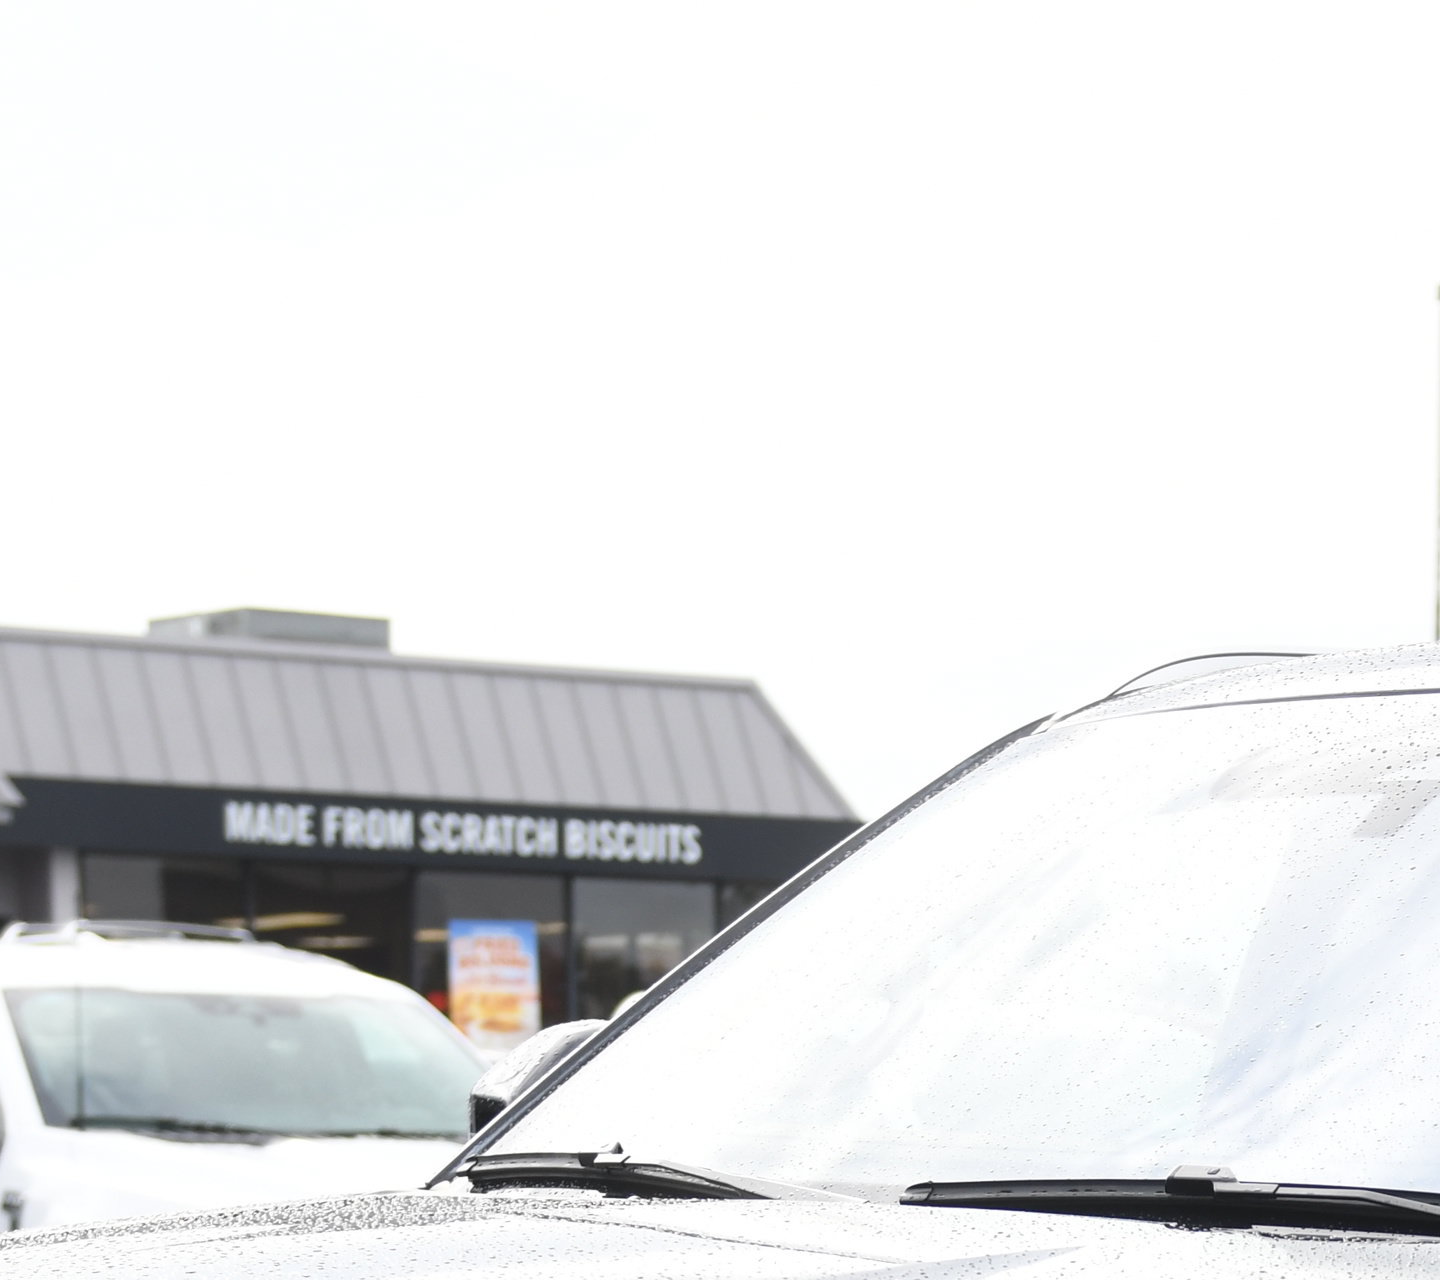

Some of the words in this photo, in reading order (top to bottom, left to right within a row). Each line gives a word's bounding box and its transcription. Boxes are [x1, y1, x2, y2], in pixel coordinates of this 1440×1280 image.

[224, 800, 317, 847] MADE
[322, 805, 413, 850] FROM
[419, 811, 559, 858] SCRATCH
[564, 818, 703, 866] BISCUITS
